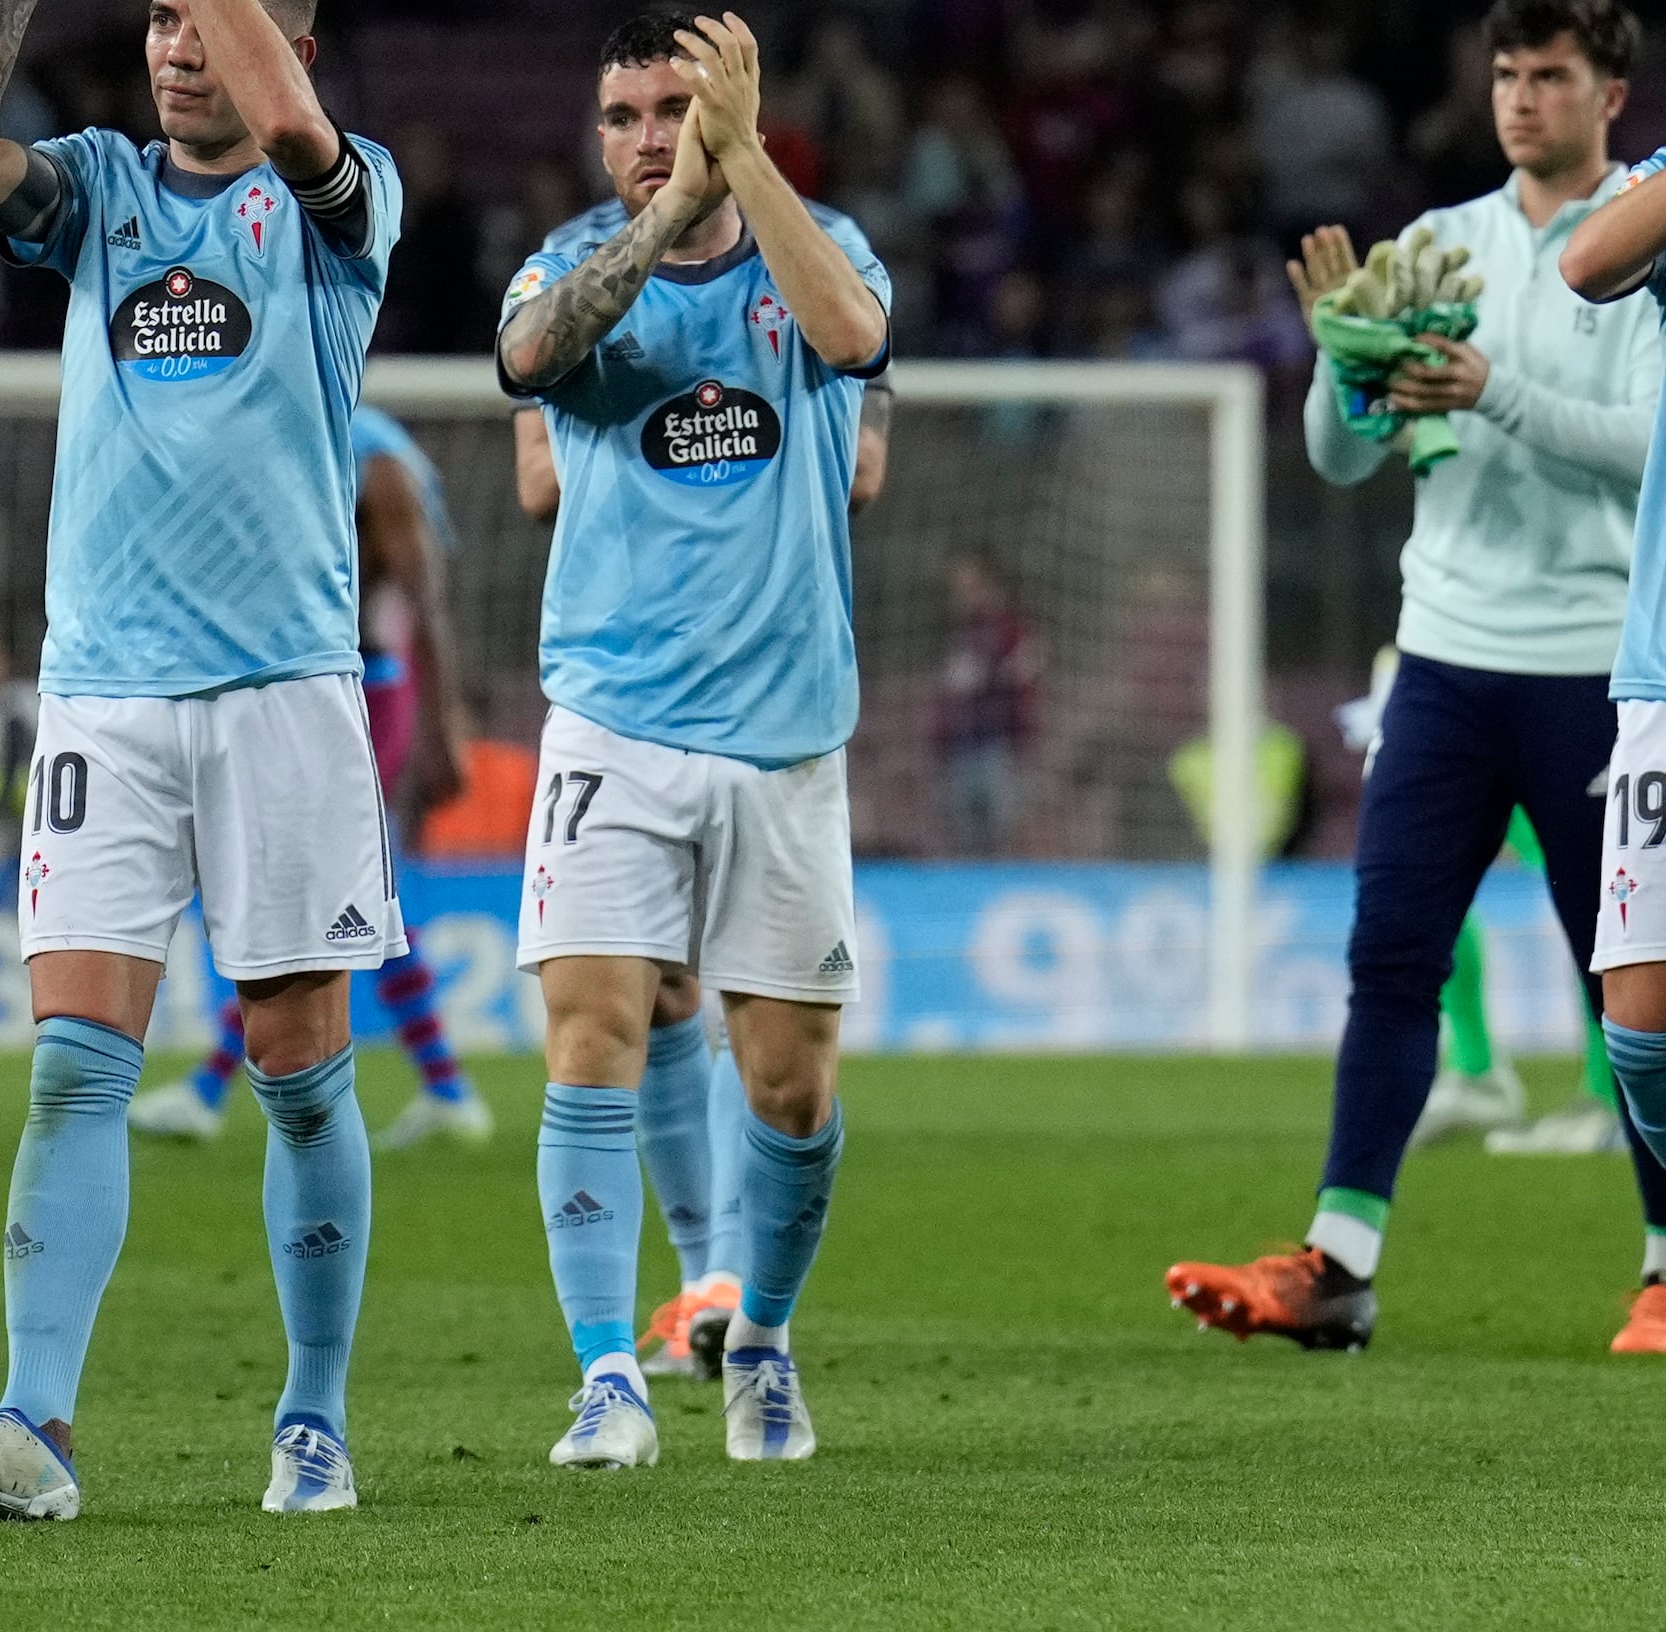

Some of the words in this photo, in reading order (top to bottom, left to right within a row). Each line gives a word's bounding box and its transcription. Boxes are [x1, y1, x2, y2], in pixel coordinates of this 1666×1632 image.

[107, 235, 141, 250] adidas
[131, 299, 227, 327] Estrella
[1574, 306, 1599, 336] 15
[134, 325, 222, 354] Galicia
[161, 354, 192, 377] 0,0
[663, 405, 759, 438] Estrella
[668, 431, 758, 463] Galicia
[700, 459, 730, 482] 0,0
[31, 751, 87, 836] 10
[541, 770, 603, 846] 17
[326, 925, 376, 940] adidas
[819, 960, 854, 972] adidas
[282, 1239, 351, 1259] adidas
